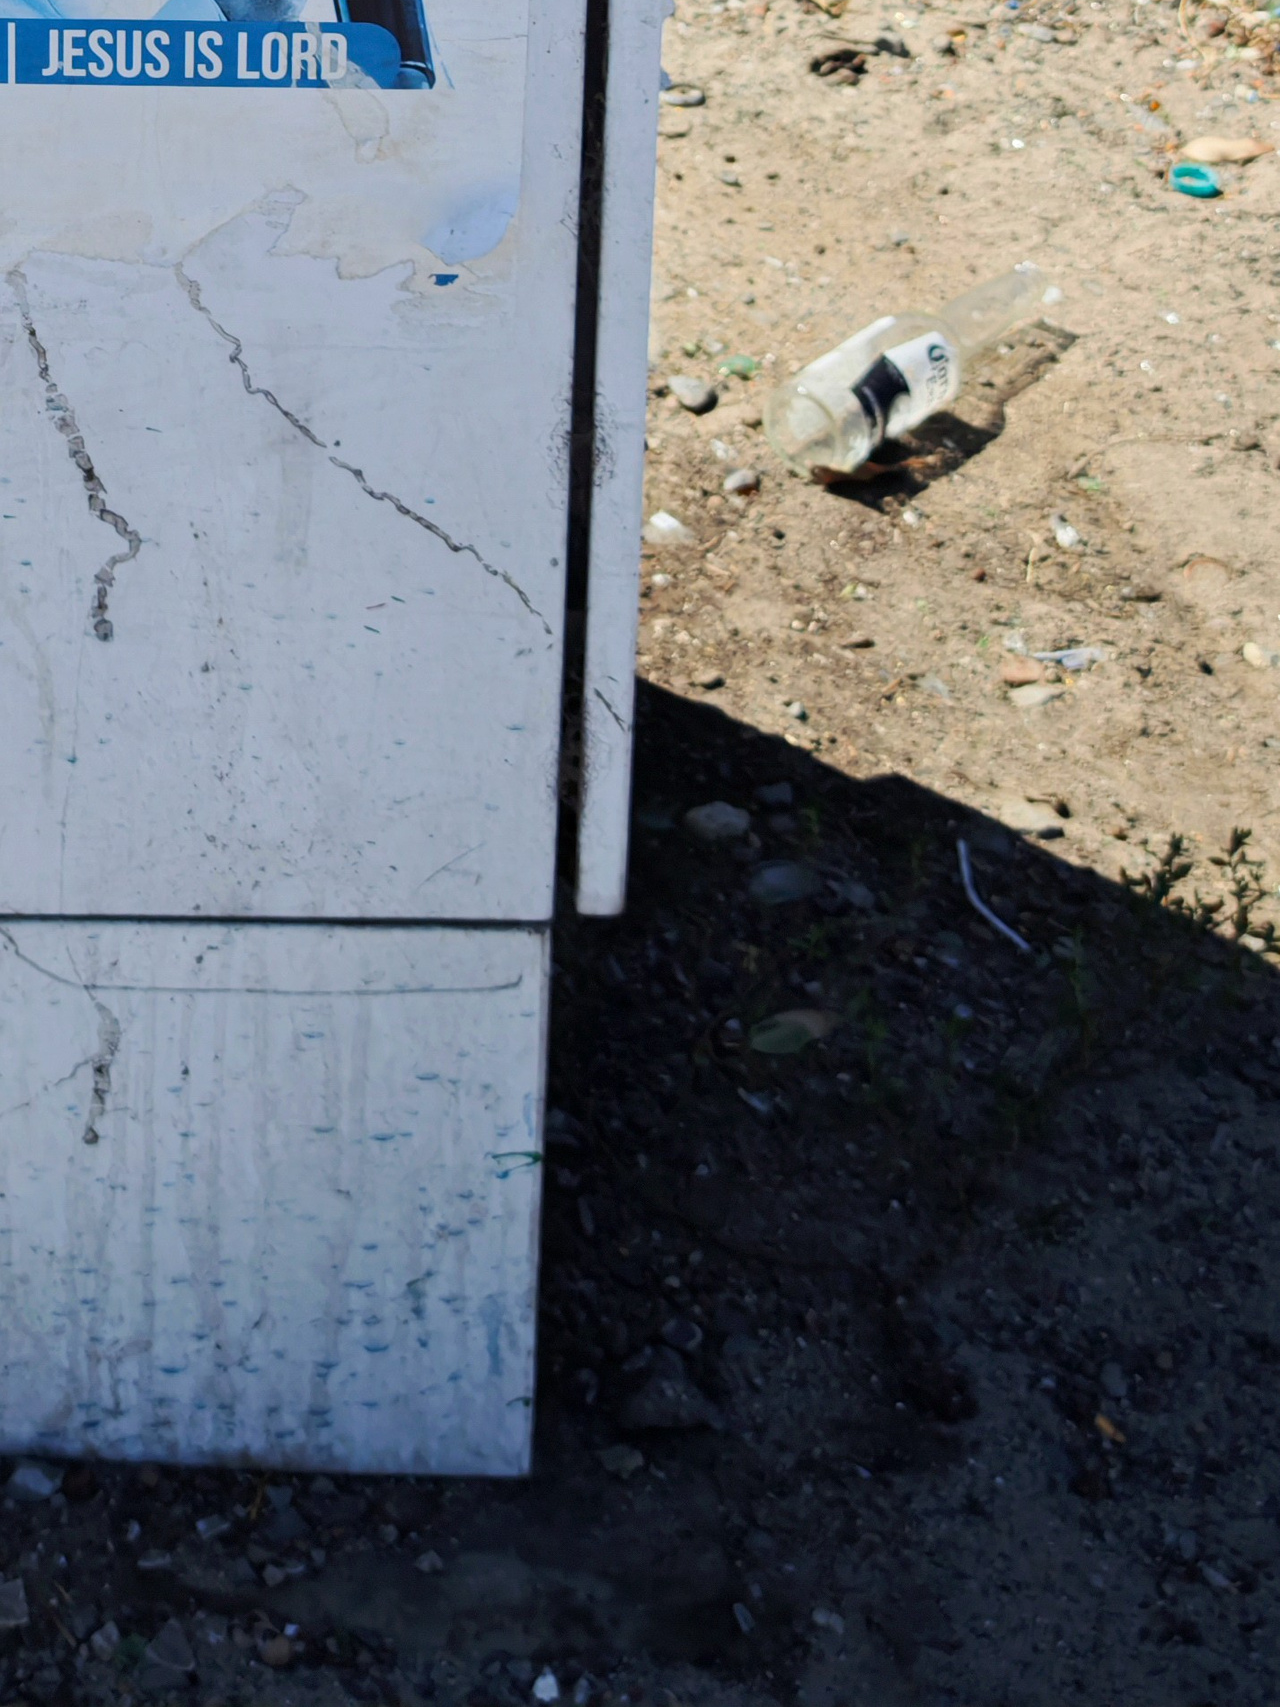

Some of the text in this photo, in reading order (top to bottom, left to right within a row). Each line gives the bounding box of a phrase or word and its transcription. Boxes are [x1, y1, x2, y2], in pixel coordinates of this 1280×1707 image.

[41, 28, 170, 79] JESUS
[184, 30, 224, 79] IS
[237, 32, 348, 81] LORD
